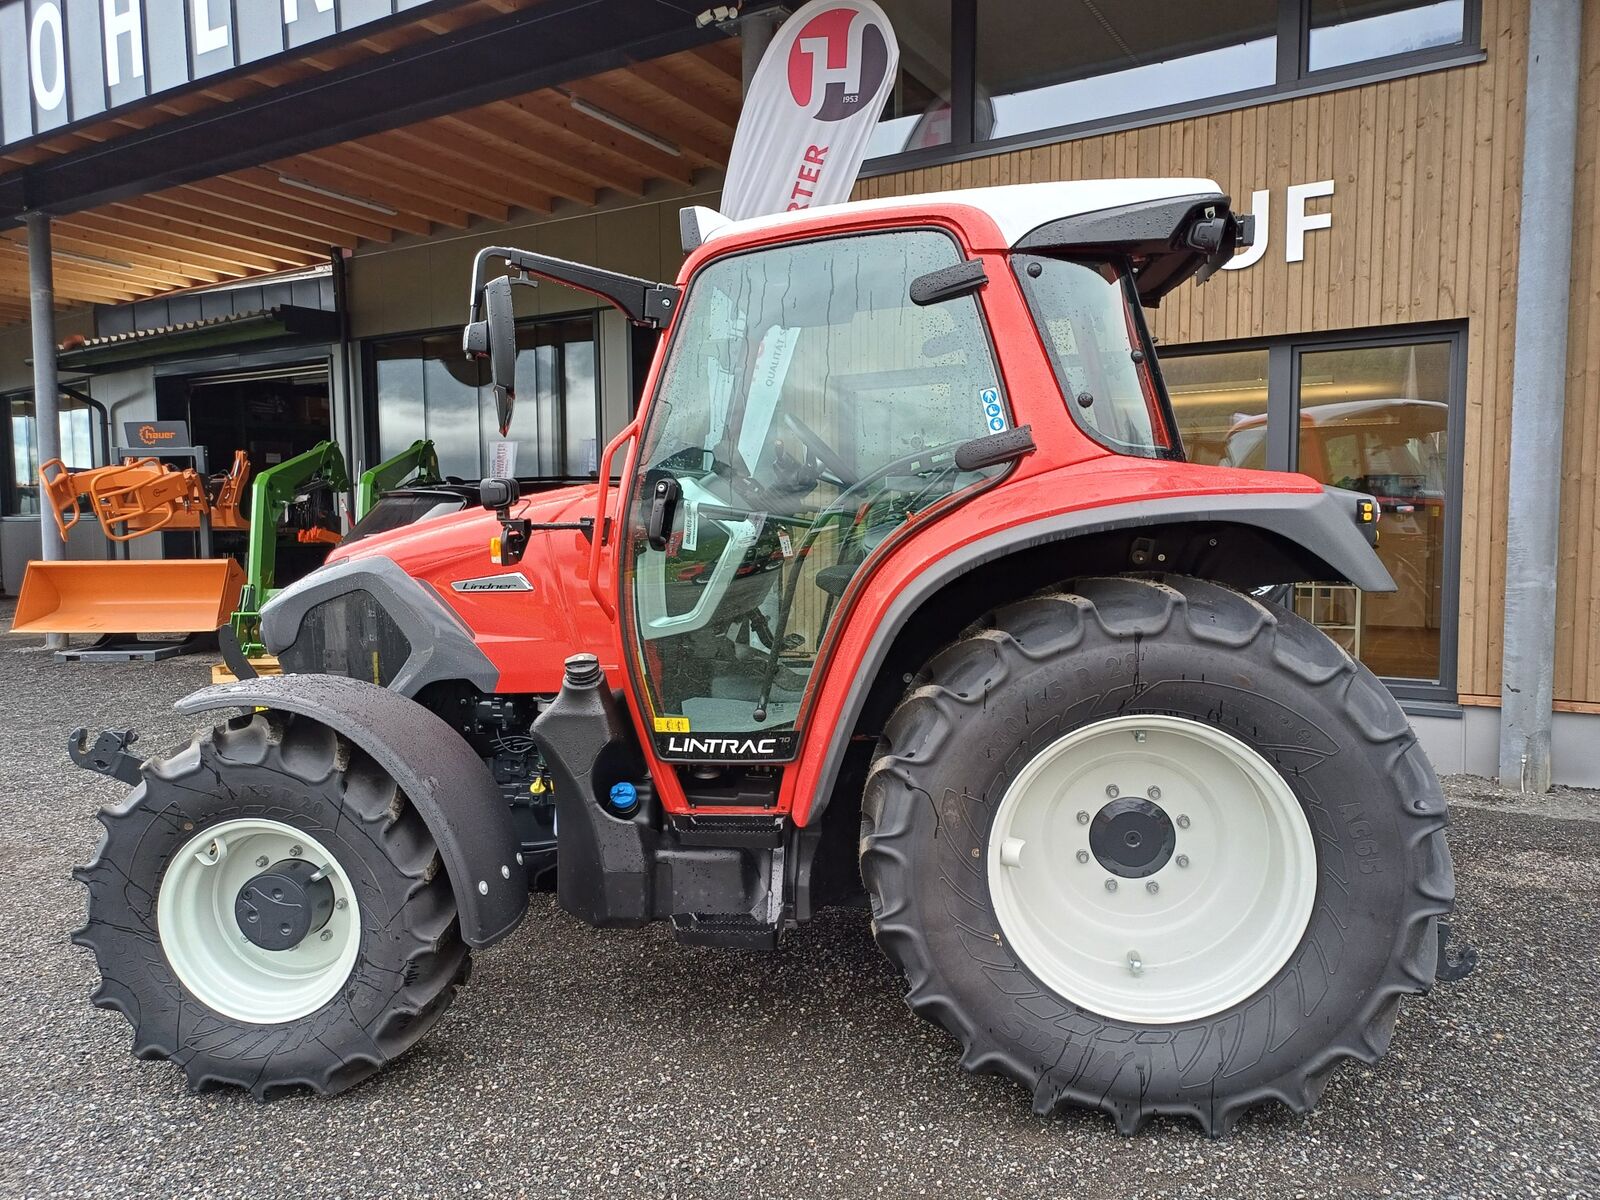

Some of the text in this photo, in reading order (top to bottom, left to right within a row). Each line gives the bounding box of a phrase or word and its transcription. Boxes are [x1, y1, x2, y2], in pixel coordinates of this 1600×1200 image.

[842, 95, 859, 104] 1953
[145, 429, 176, 439] hauer
[462, 582, 517, 590] Lindner
[668, 737, 777, 754] LINTRAC
